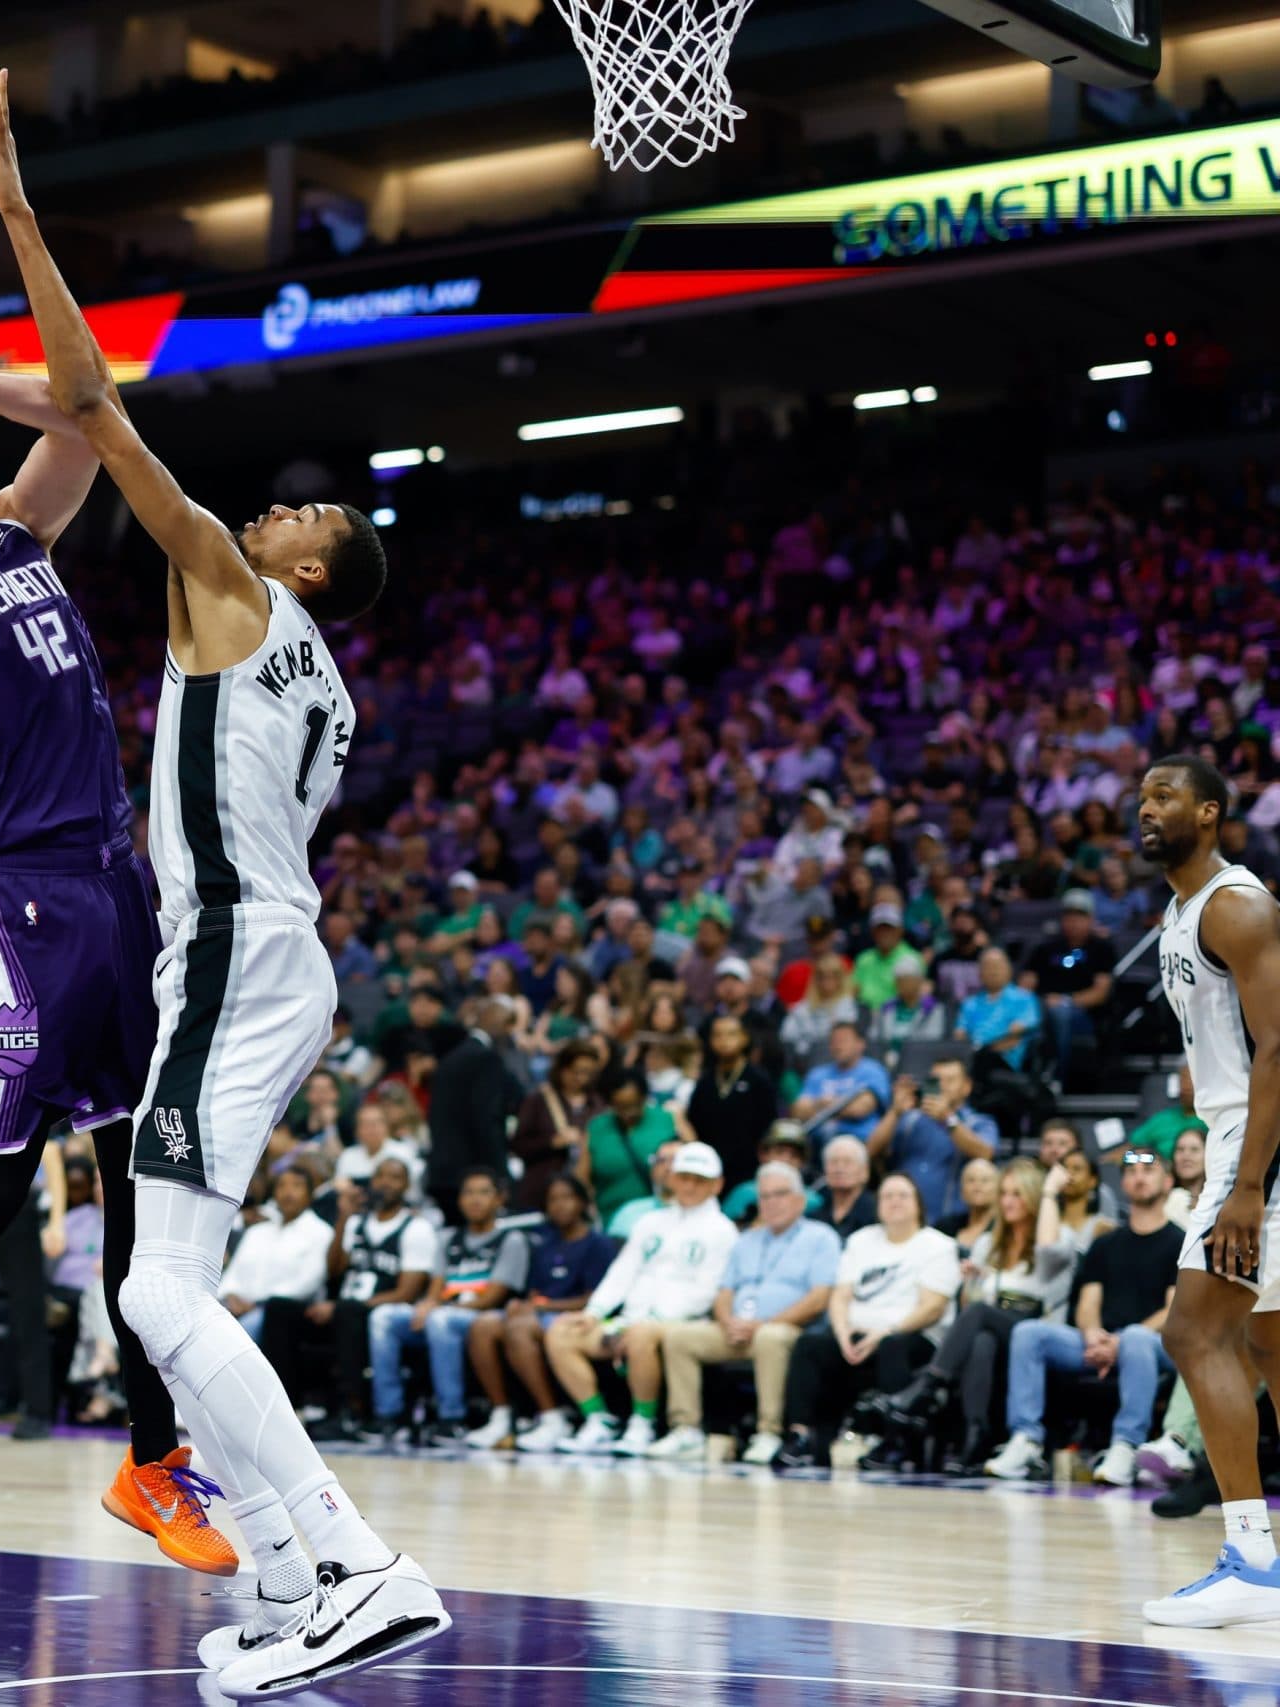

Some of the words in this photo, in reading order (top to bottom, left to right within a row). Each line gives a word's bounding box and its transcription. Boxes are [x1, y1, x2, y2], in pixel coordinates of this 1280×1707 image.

[832, 152, 1234, 264] SOMETHING
[12, 609, 80, 678] 42
[256, 641, 350, 768] WEMBMA
[294, 700, 334, 808] 1
